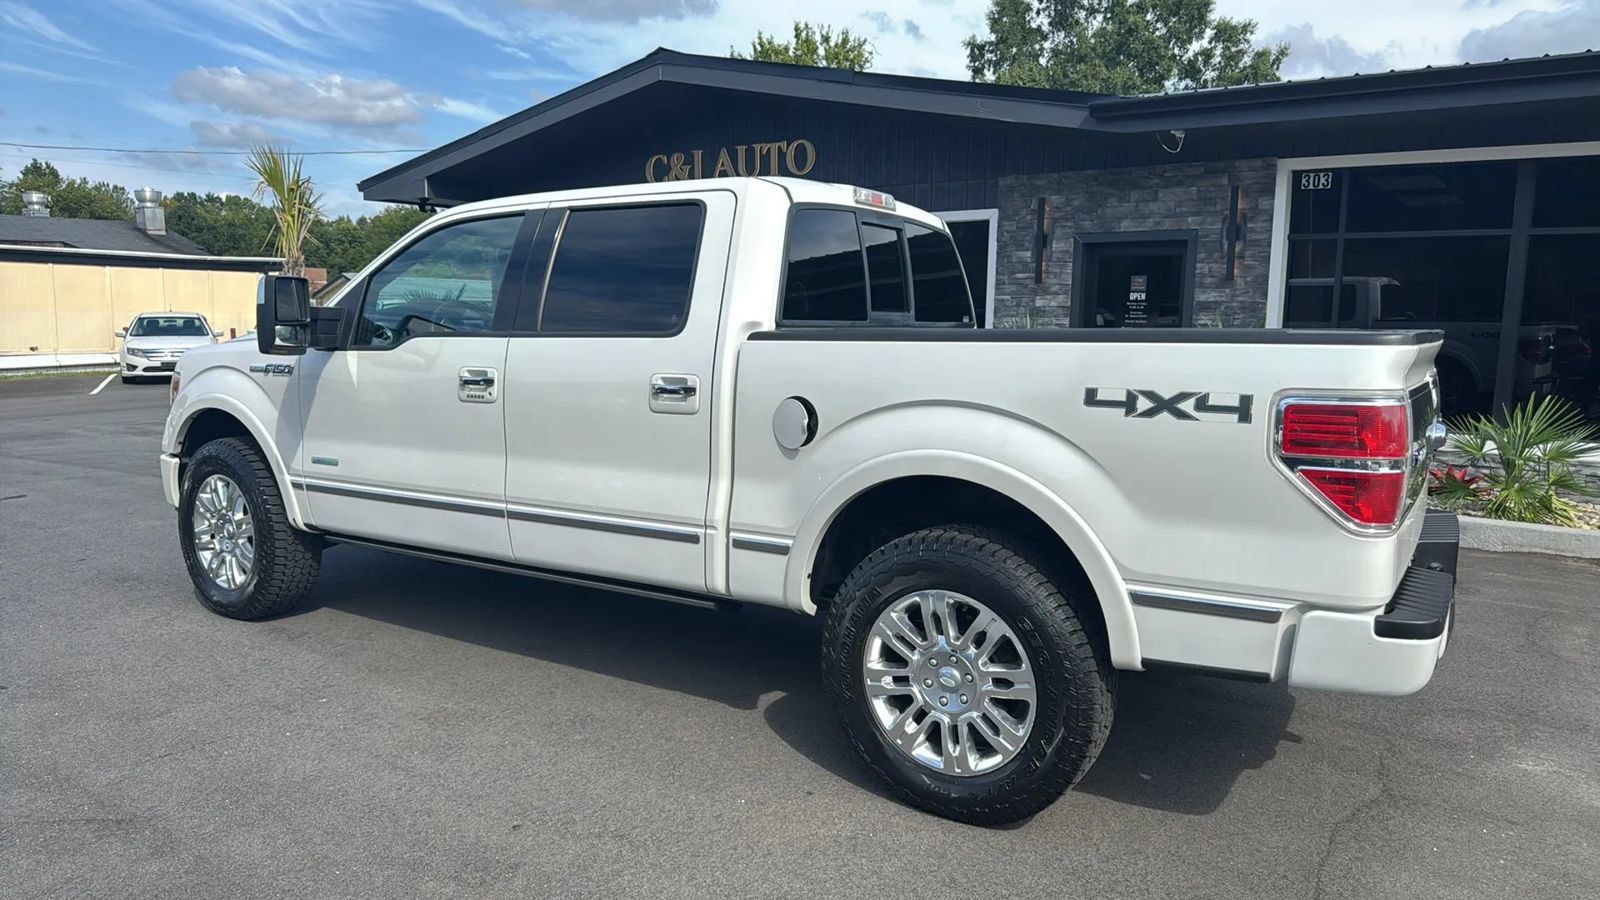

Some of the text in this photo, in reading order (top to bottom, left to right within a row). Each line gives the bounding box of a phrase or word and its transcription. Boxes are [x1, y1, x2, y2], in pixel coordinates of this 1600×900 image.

[713, 139, 817, 178] AUTO
[1302, 173, 1331, 190] 303
[1129, 292, 1146, 301] OPEN
